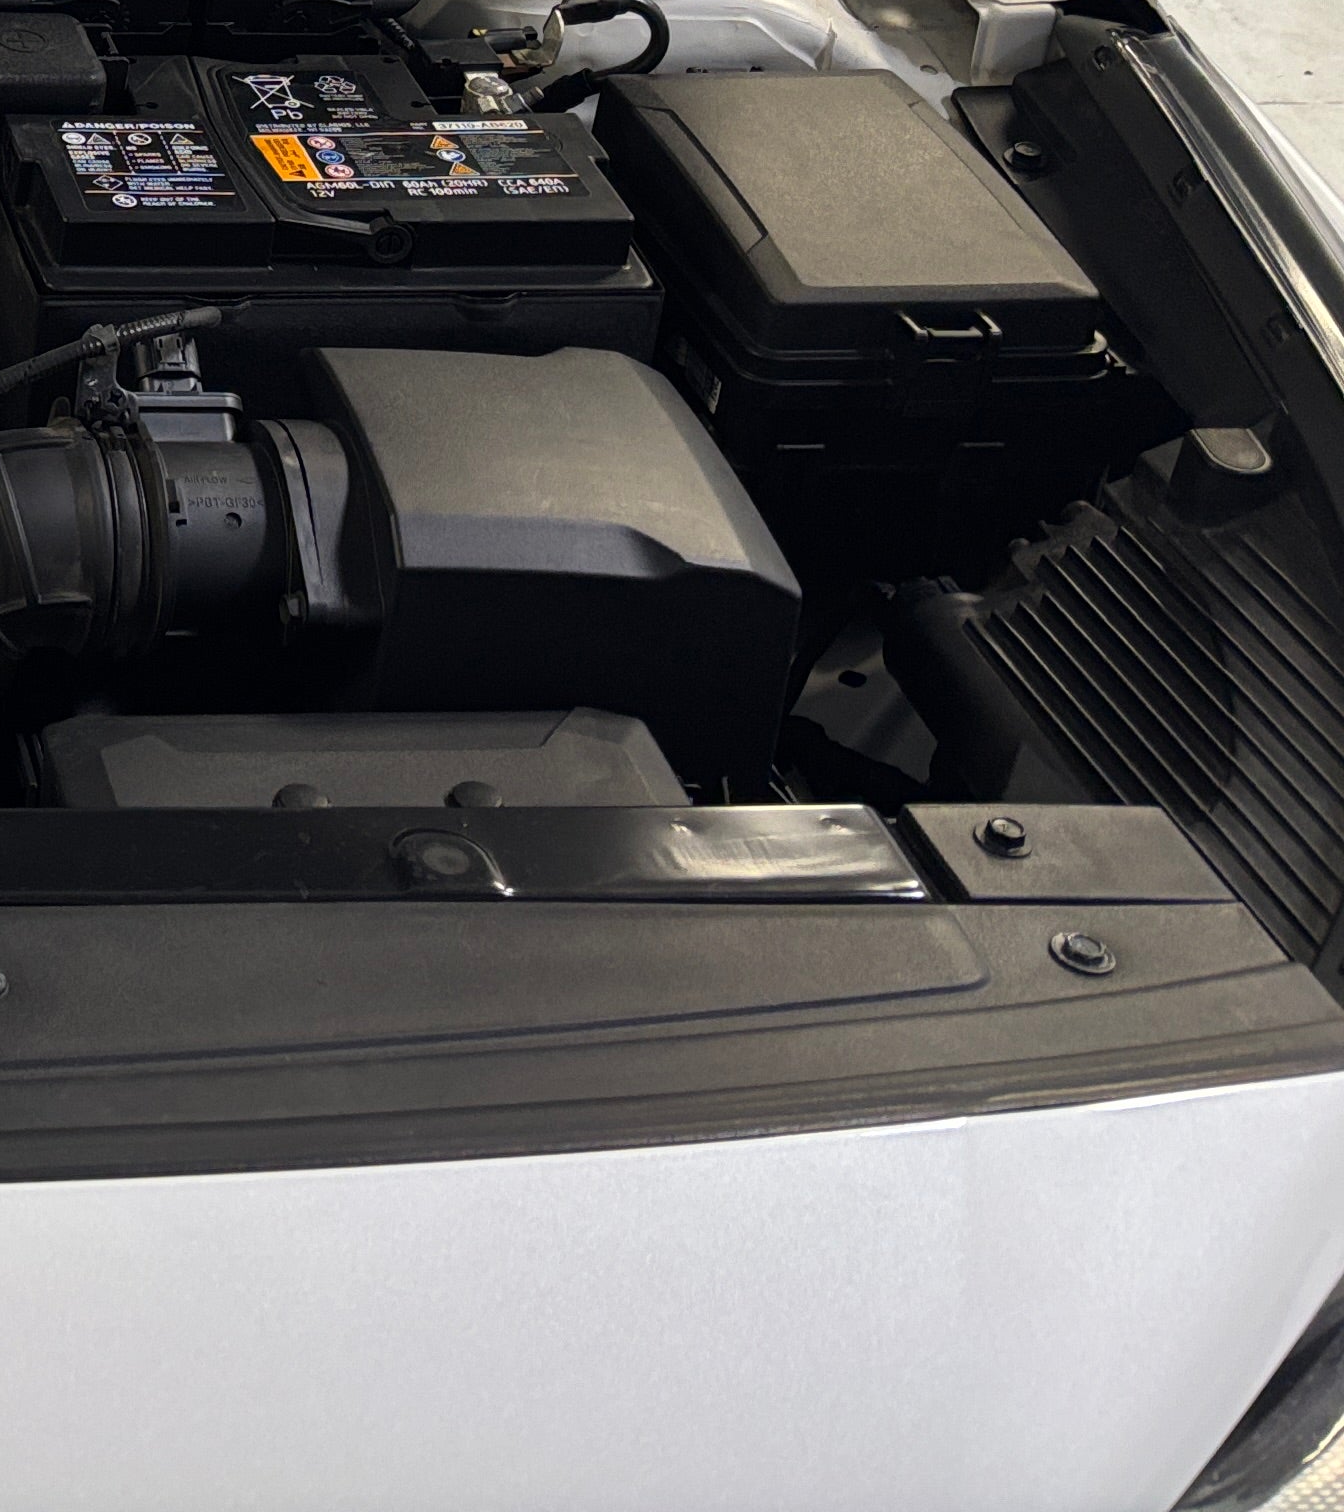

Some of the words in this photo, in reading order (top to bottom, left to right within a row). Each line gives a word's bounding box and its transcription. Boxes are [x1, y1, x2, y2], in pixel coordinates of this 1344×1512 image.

[270, 109, 303, 120] Pb
[74, 122, 195, 130] DANGER/POISON
[402, 179, 438, 188] 60Ah
[441, 179, 489, 188] (20HR)
[497, 179, 527, 187] CCA
[528, 178, 565, 187] 640A
[310, 190, 336, 198] 12V
[408, 187, 427, 196] RC
[428, 187, 479, 195] 100min
